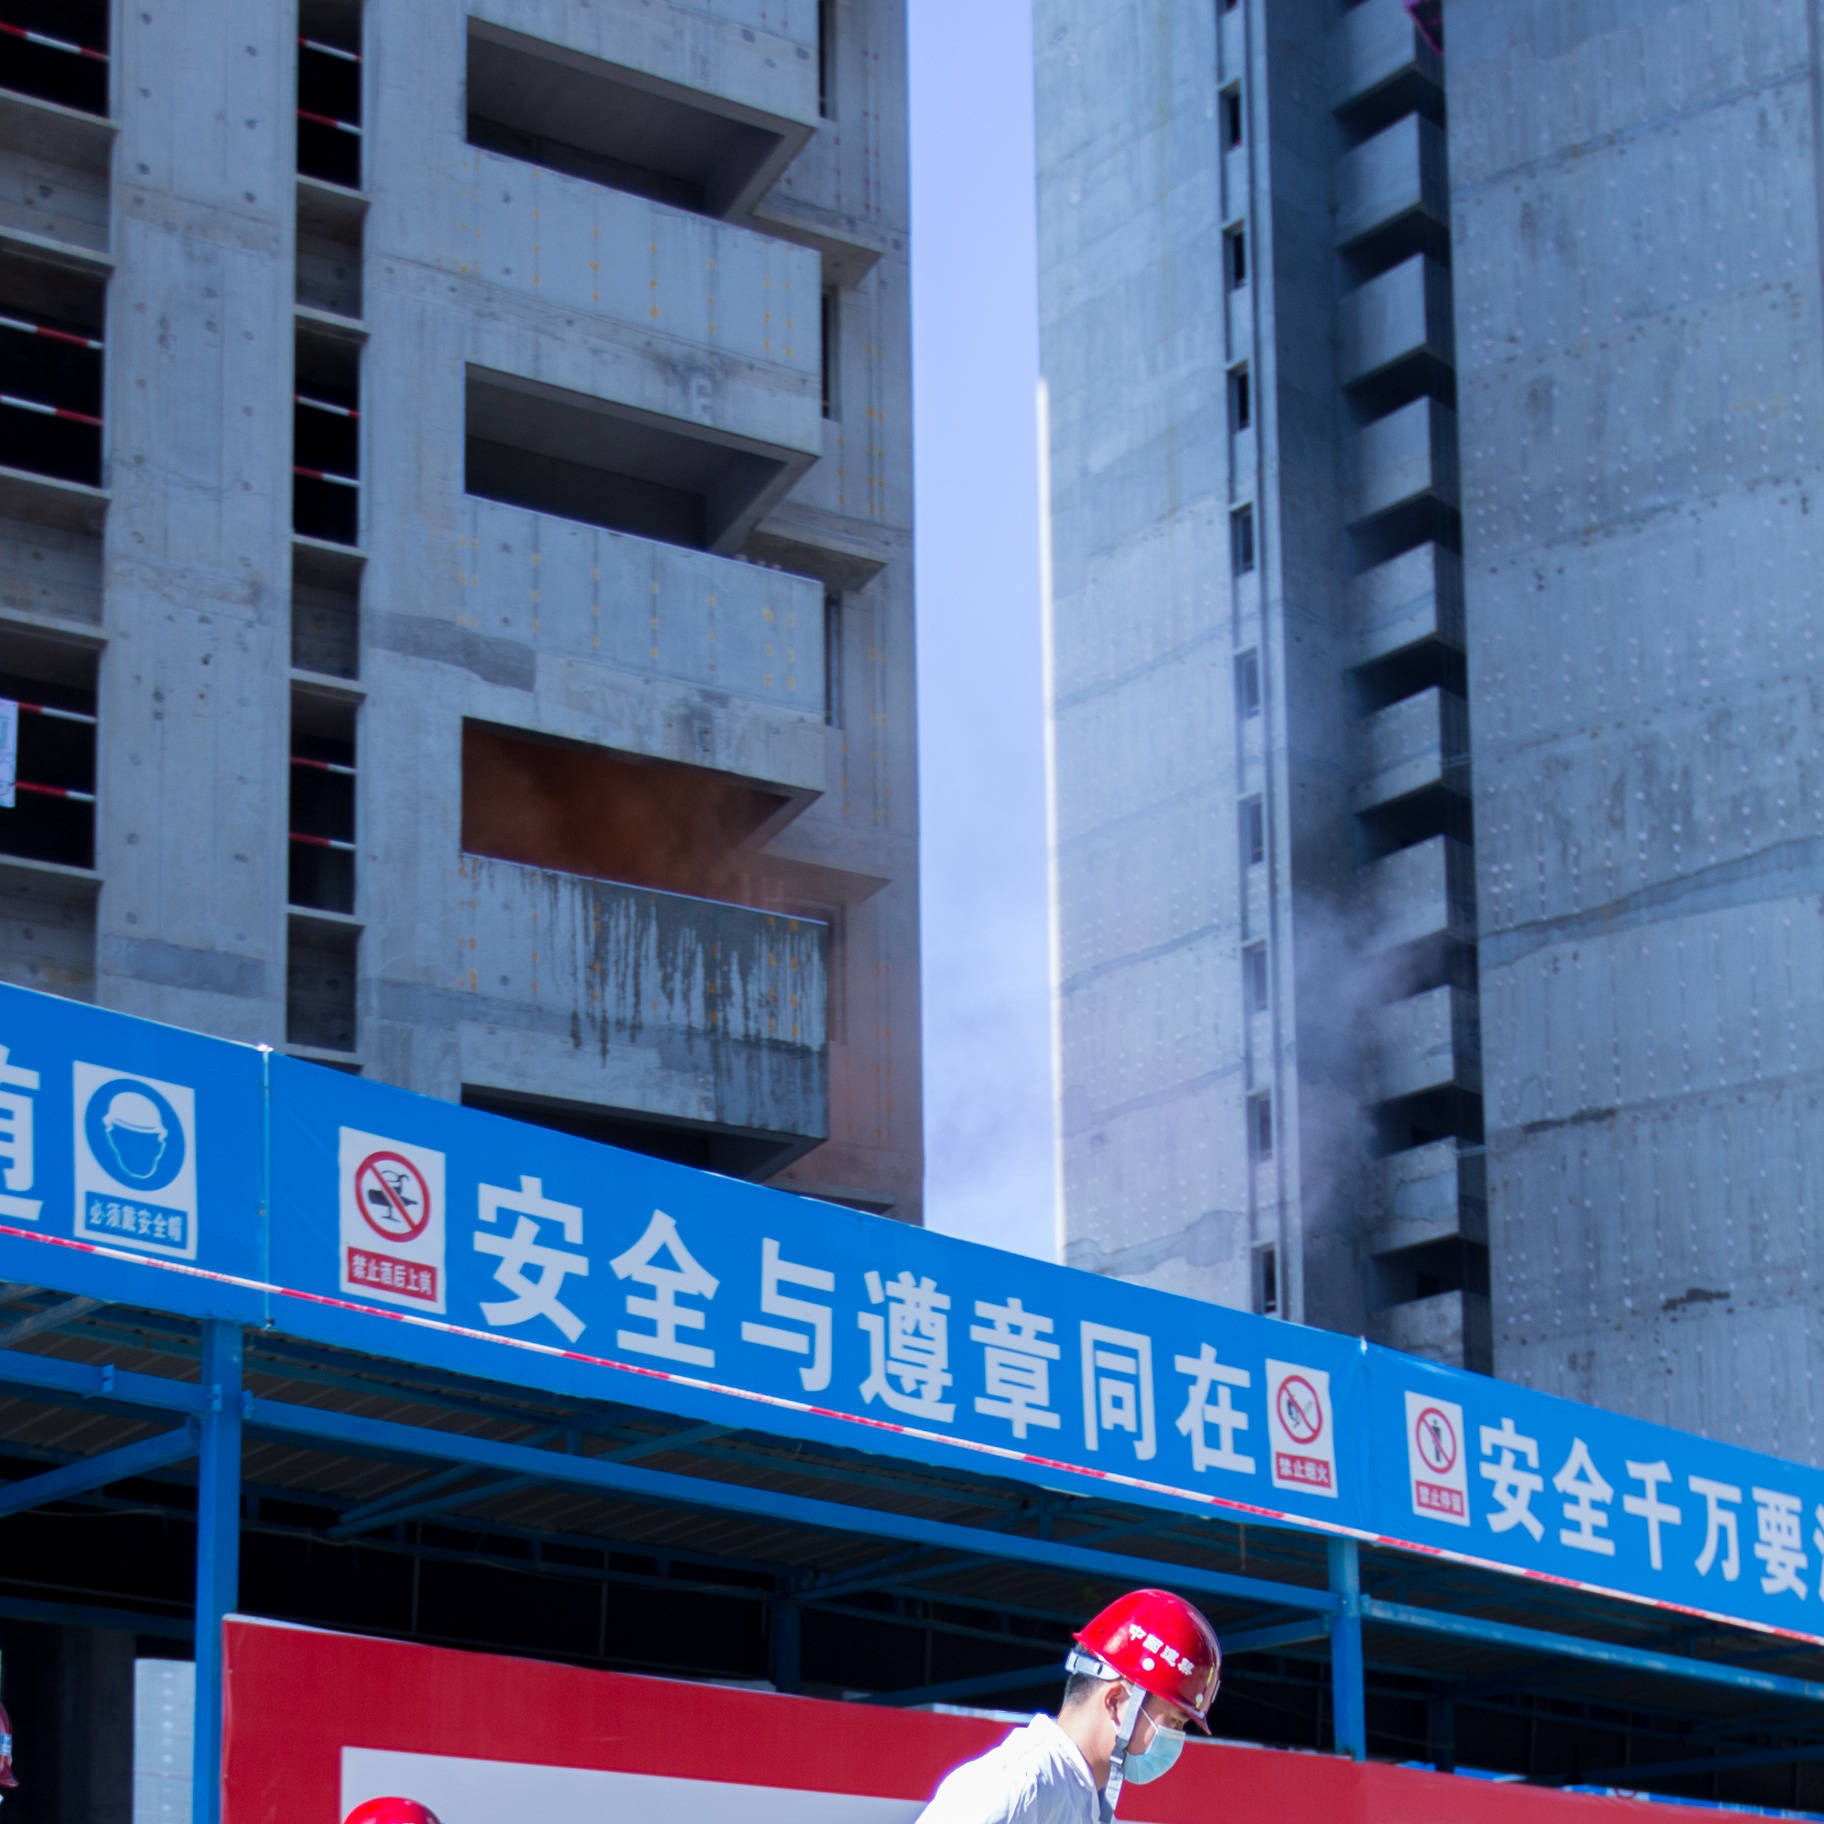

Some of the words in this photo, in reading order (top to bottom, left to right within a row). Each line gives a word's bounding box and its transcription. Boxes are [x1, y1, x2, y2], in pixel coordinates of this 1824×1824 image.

[89, 1199, 183, 1242] 必须戴安全帽
[352, 1254, 432, 1296] 禁止酒后上岗
[471, 1174, 1258, 1478] 安全与遵章同在
